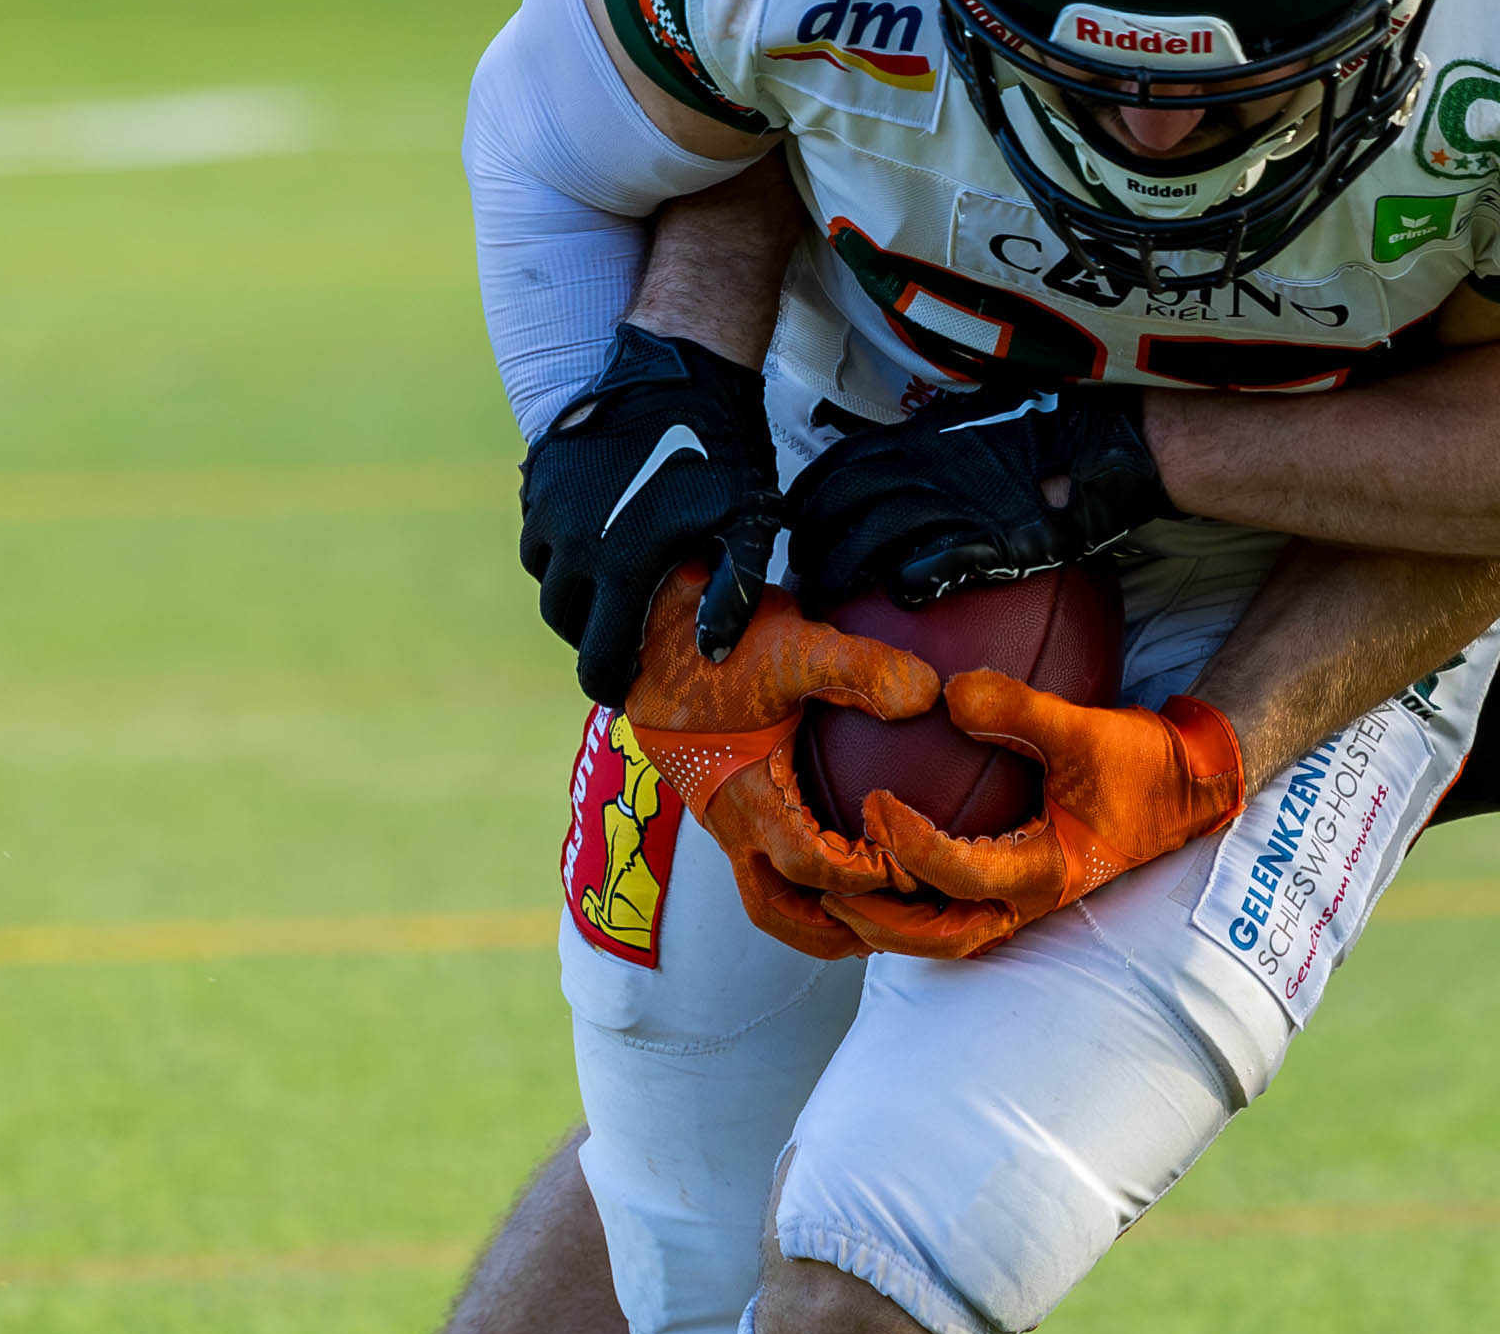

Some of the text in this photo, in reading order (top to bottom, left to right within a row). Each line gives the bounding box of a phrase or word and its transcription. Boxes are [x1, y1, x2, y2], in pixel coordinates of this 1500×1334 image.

[1076, 17, 1214, 54] Riddell
[1126, 178, 1198, 198] Riddell
[1145, 303, 1220, 322] KIEL
[1258, 701, 1396, 976] SCHLESWIG-HOLSTEIN
